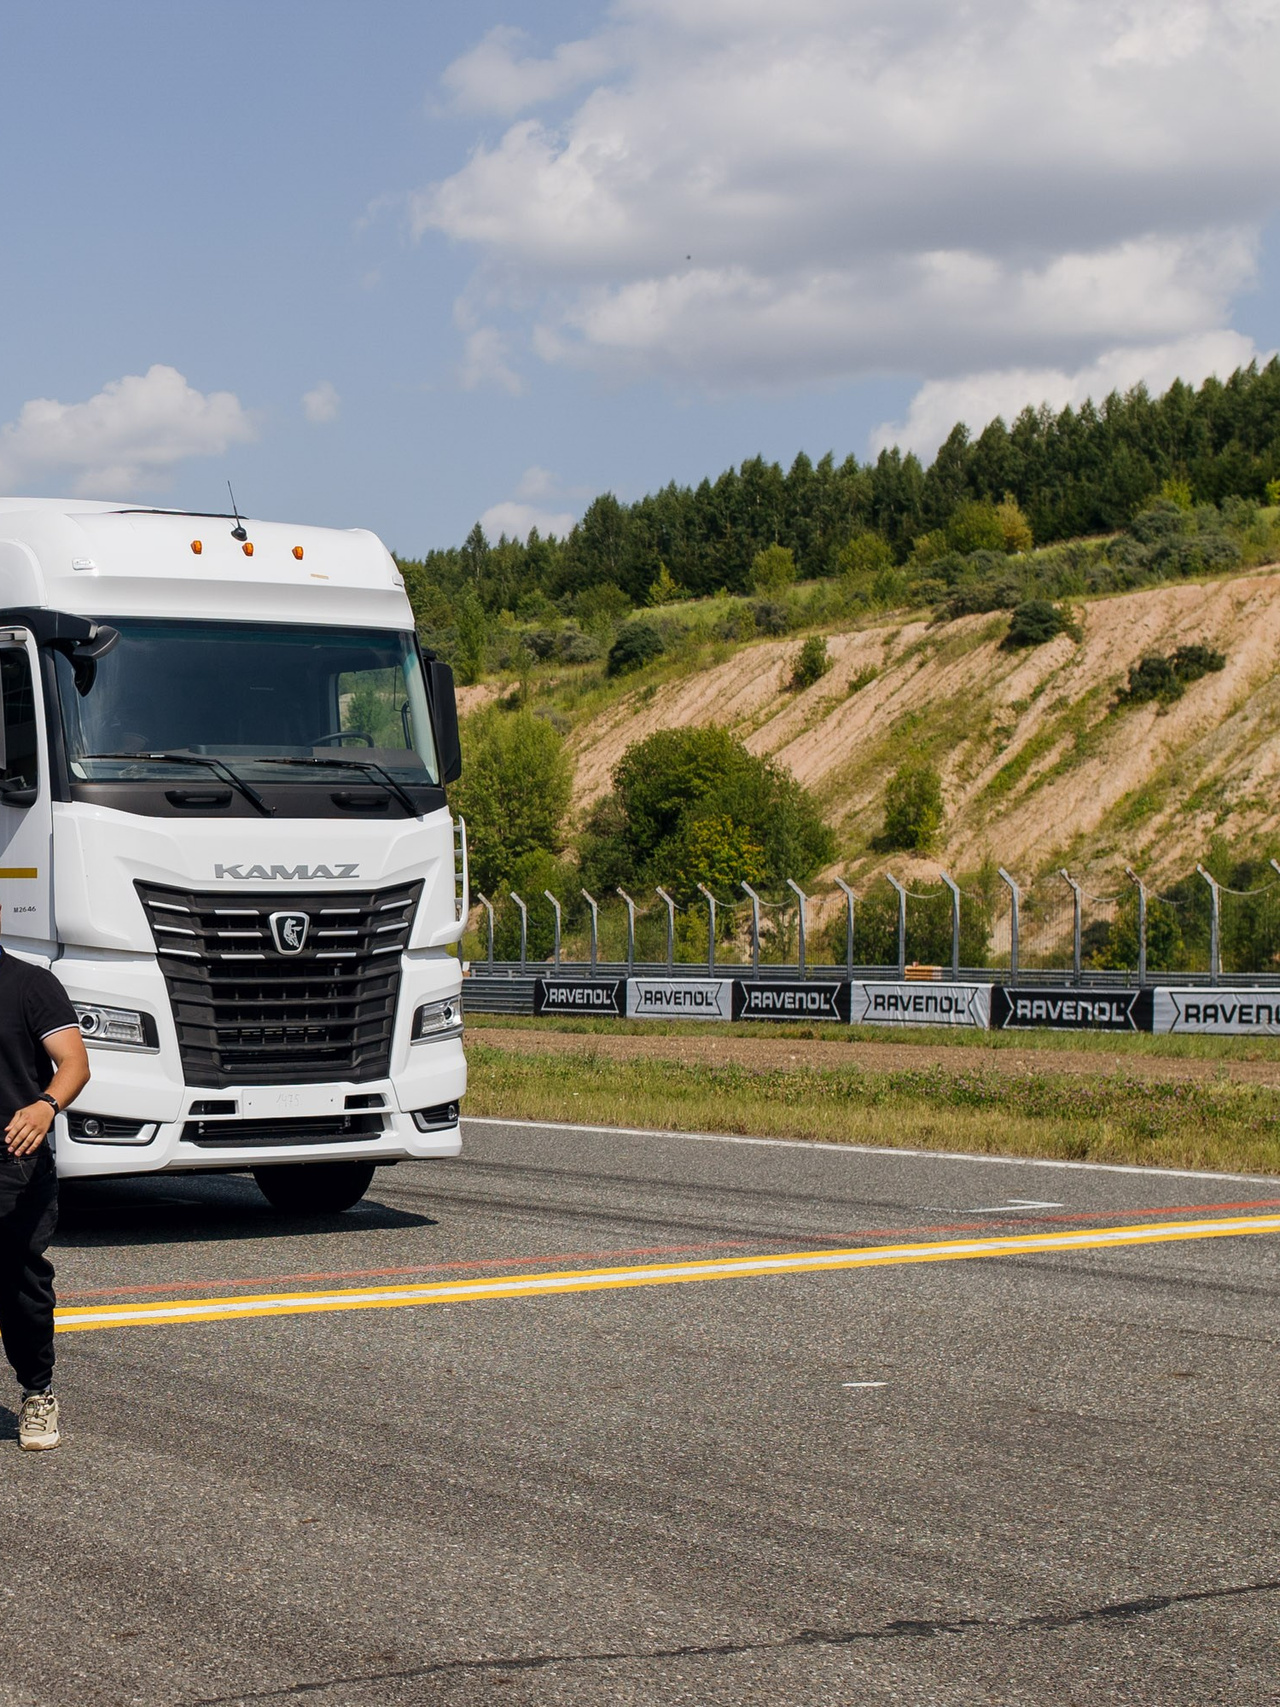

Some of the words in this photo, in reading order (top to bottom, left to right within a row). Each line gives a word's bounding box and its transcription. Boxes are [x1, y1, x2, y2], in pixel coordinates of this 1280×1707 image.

[214, 863, 360, 880] KAMAZ
[549, 988, 610, 1005] RAVENOL
[644, 990, 713, 1006] RAVENOL
[750, 991, 830, 1010] RAVENOL
[873, 994, 966, 1014] RAVENOL
[1016, 999, 1125, 1022] RAVENOL
